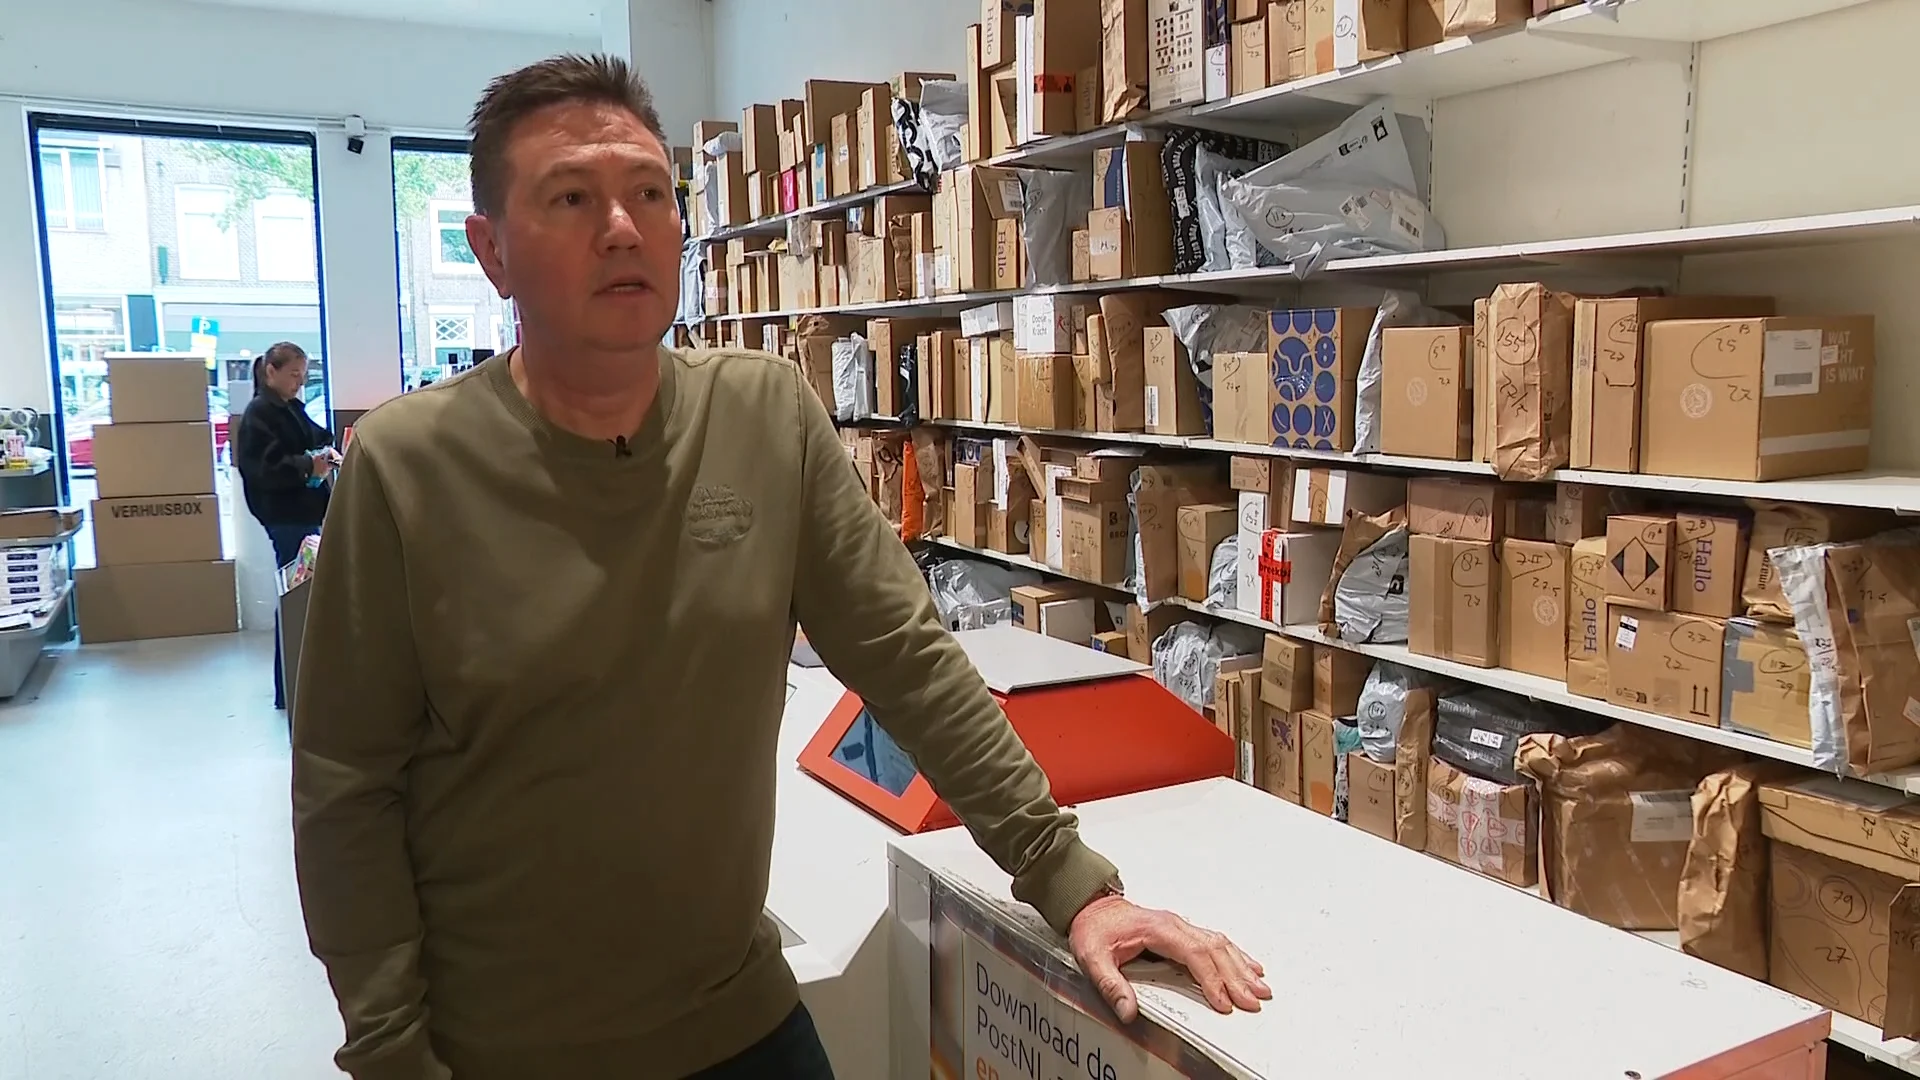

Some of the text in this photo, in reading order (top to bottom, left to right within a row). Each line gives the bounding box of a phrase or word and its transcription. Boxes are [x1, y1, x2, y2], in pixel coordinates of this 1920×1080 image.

[997, 231, 1007, 279] Hallo
[1497, 325, 1526, 353] 155
[1828, 330, 1850, 346] WAT
[111, 502, 203, 519] VERHUISBOX
[1694, 538, 1713, 593] Hallo
[1581, 597, 1598, 653] Hallo
[1832, 888, 1854, 919] 79
[1814, 946, 1854, 965] 27
[976, 960, 1080, 1068] Download
